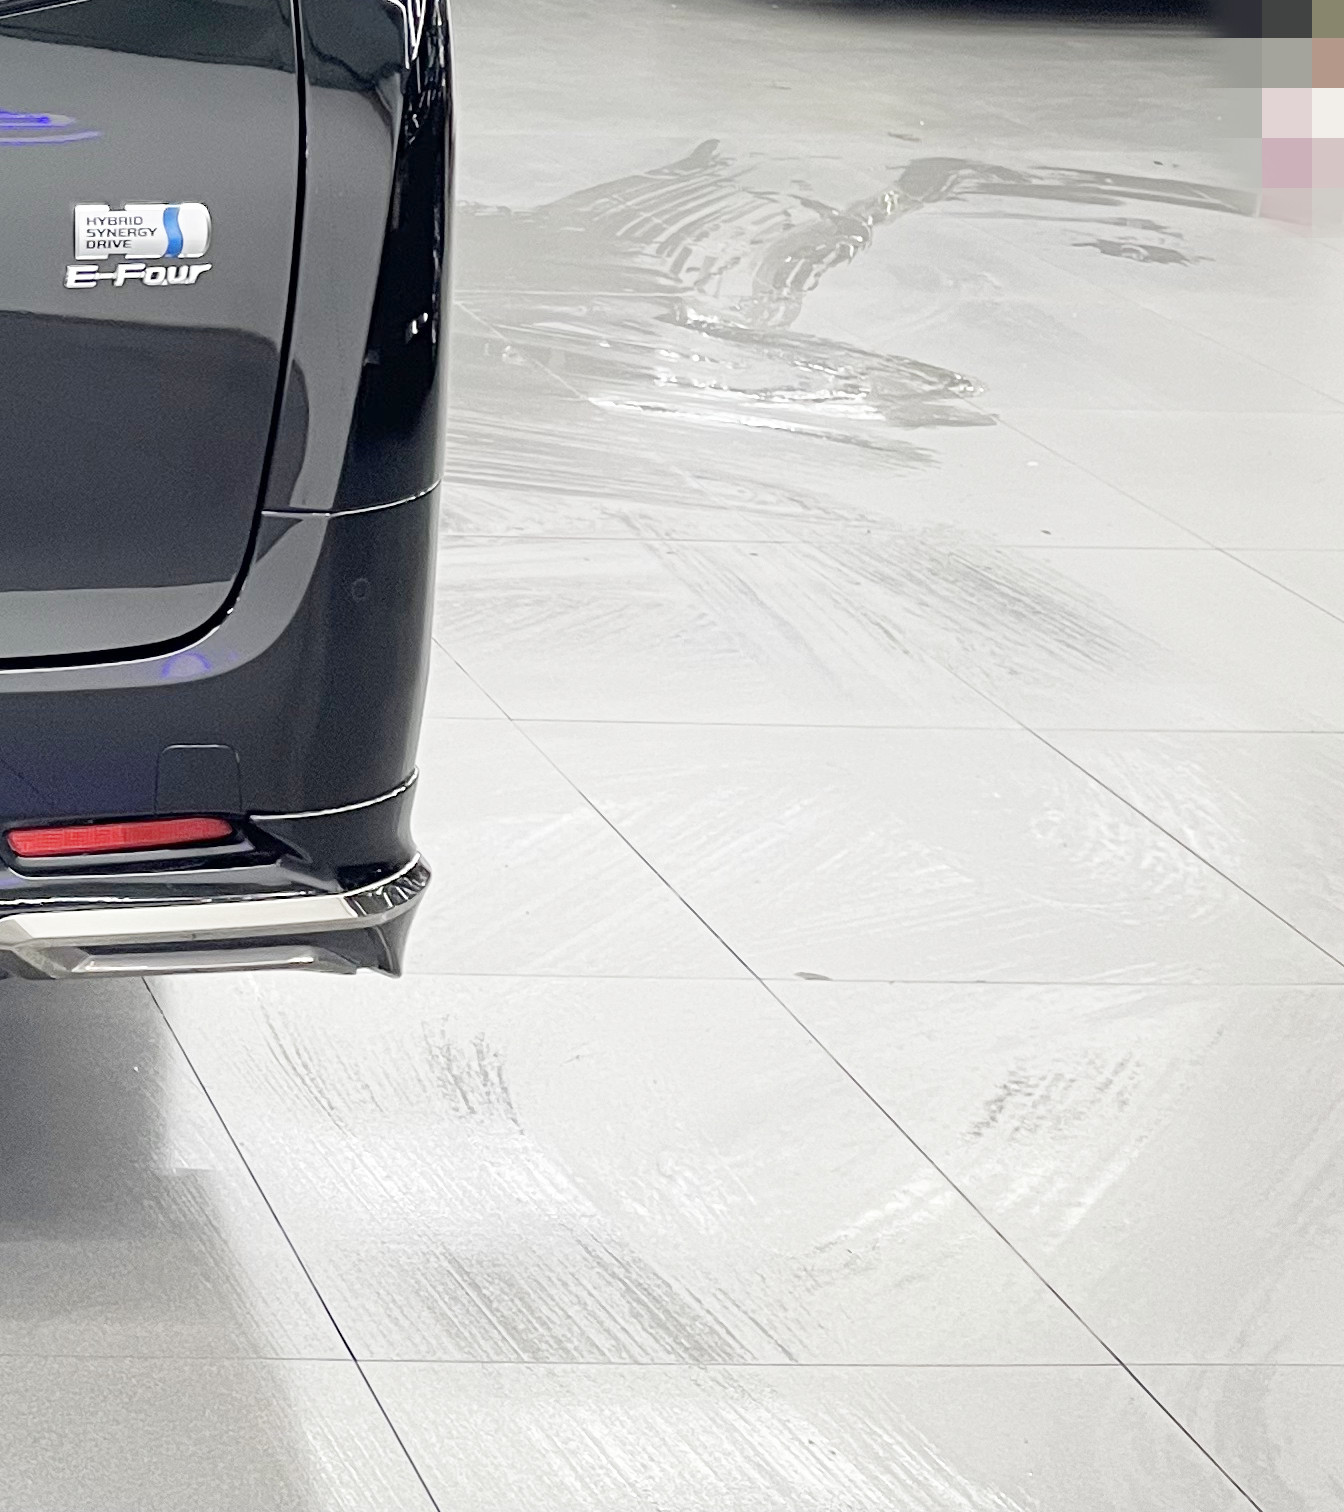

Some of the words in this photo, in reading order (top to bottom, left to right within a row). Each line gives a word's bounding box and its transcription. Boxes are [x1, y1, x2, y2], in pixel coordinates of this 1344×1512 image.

[85, 216, 144, 226] HYBRID
[85, 227, 158, 238] SYNERGY
[85, 239, 133, 250] DRIVE
[64, 263, 213, 289] E-Four
